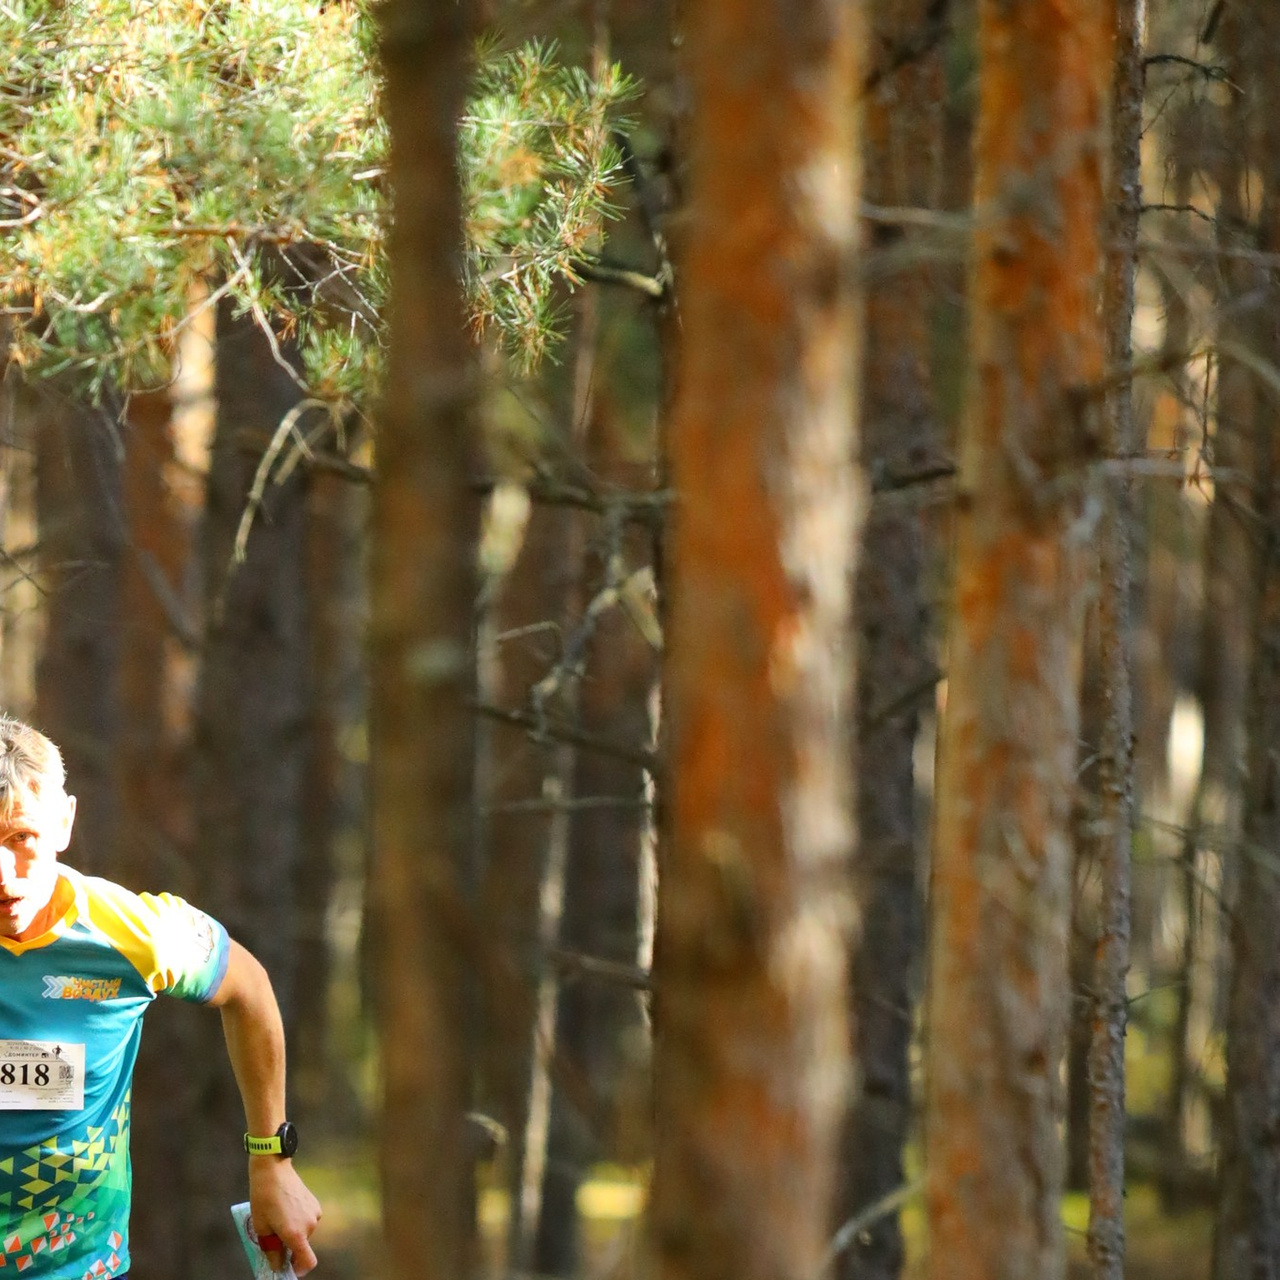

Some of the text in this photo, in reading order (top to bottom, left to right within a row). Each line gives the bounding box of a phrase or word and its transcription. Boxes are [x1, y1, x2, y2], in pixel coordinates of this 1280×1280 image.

[71, 977, 122, 989] ЧИСТЫЙ
[62, 986, 119, 1002] ВОЗДУХ
[0, 1063, 50, 1086] 818
